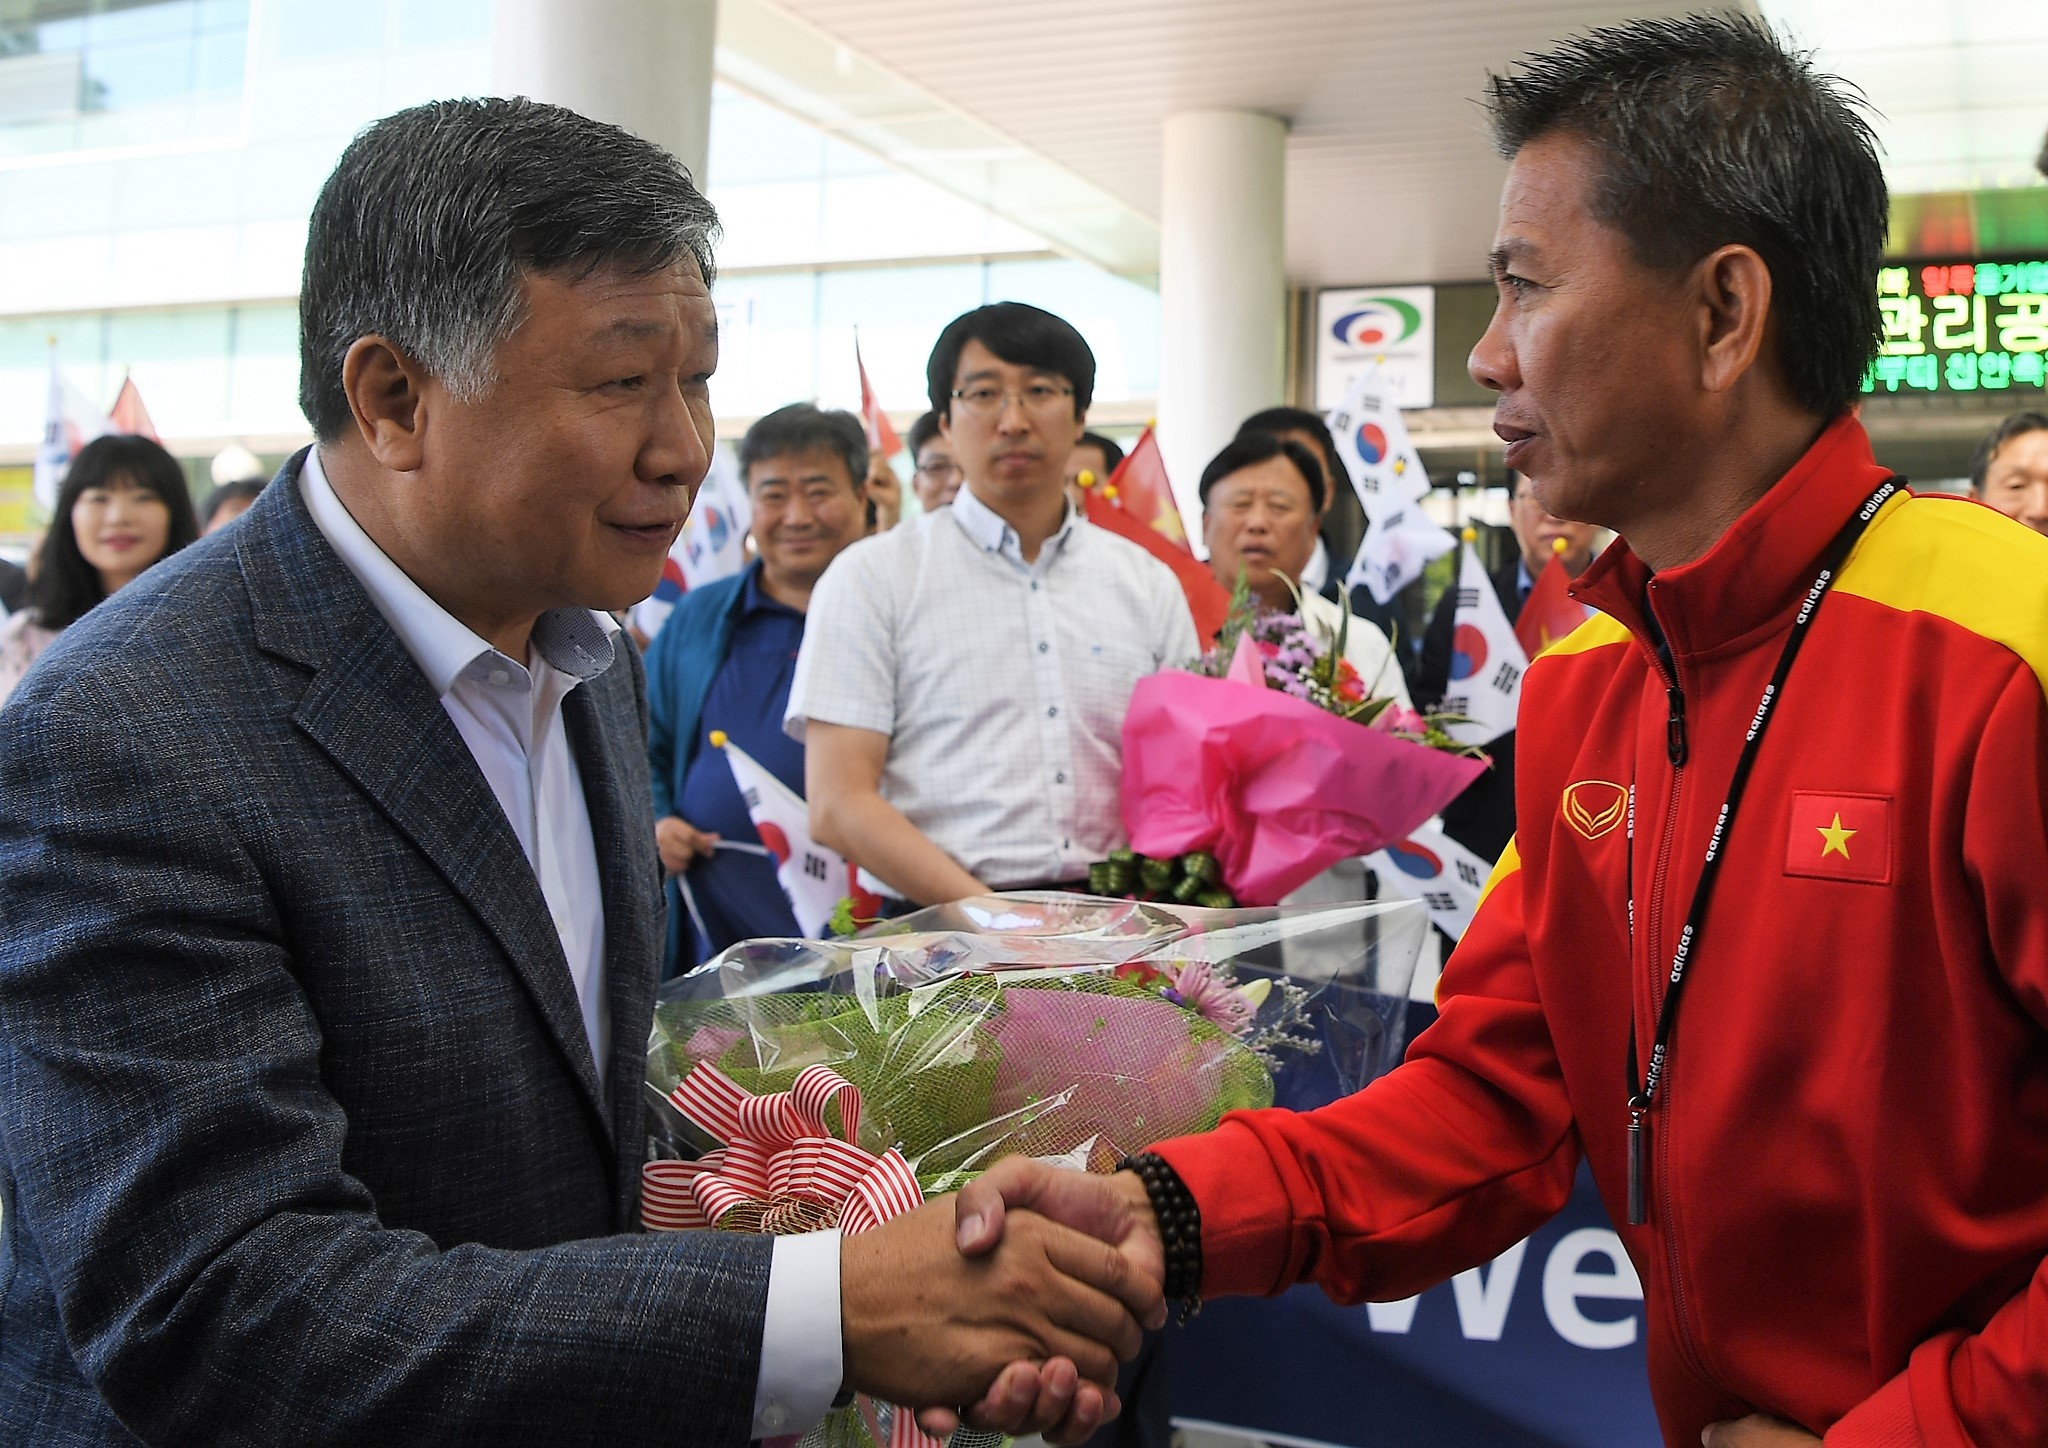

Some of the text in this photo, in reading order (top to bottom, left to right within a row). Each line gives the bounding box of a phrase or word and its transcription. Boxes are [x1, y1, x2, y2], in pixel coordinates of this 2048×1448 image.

[1944, 351, 2048, 391] 천안축
[1860, 482, 1895, 521] adidas
[1796, 569, 1832, 625] adidas
[1745, 684, 1775, 742] adidas
[1705, 803, 1729, 862] adidas
[1670, 924, 1694, 983] adidas
